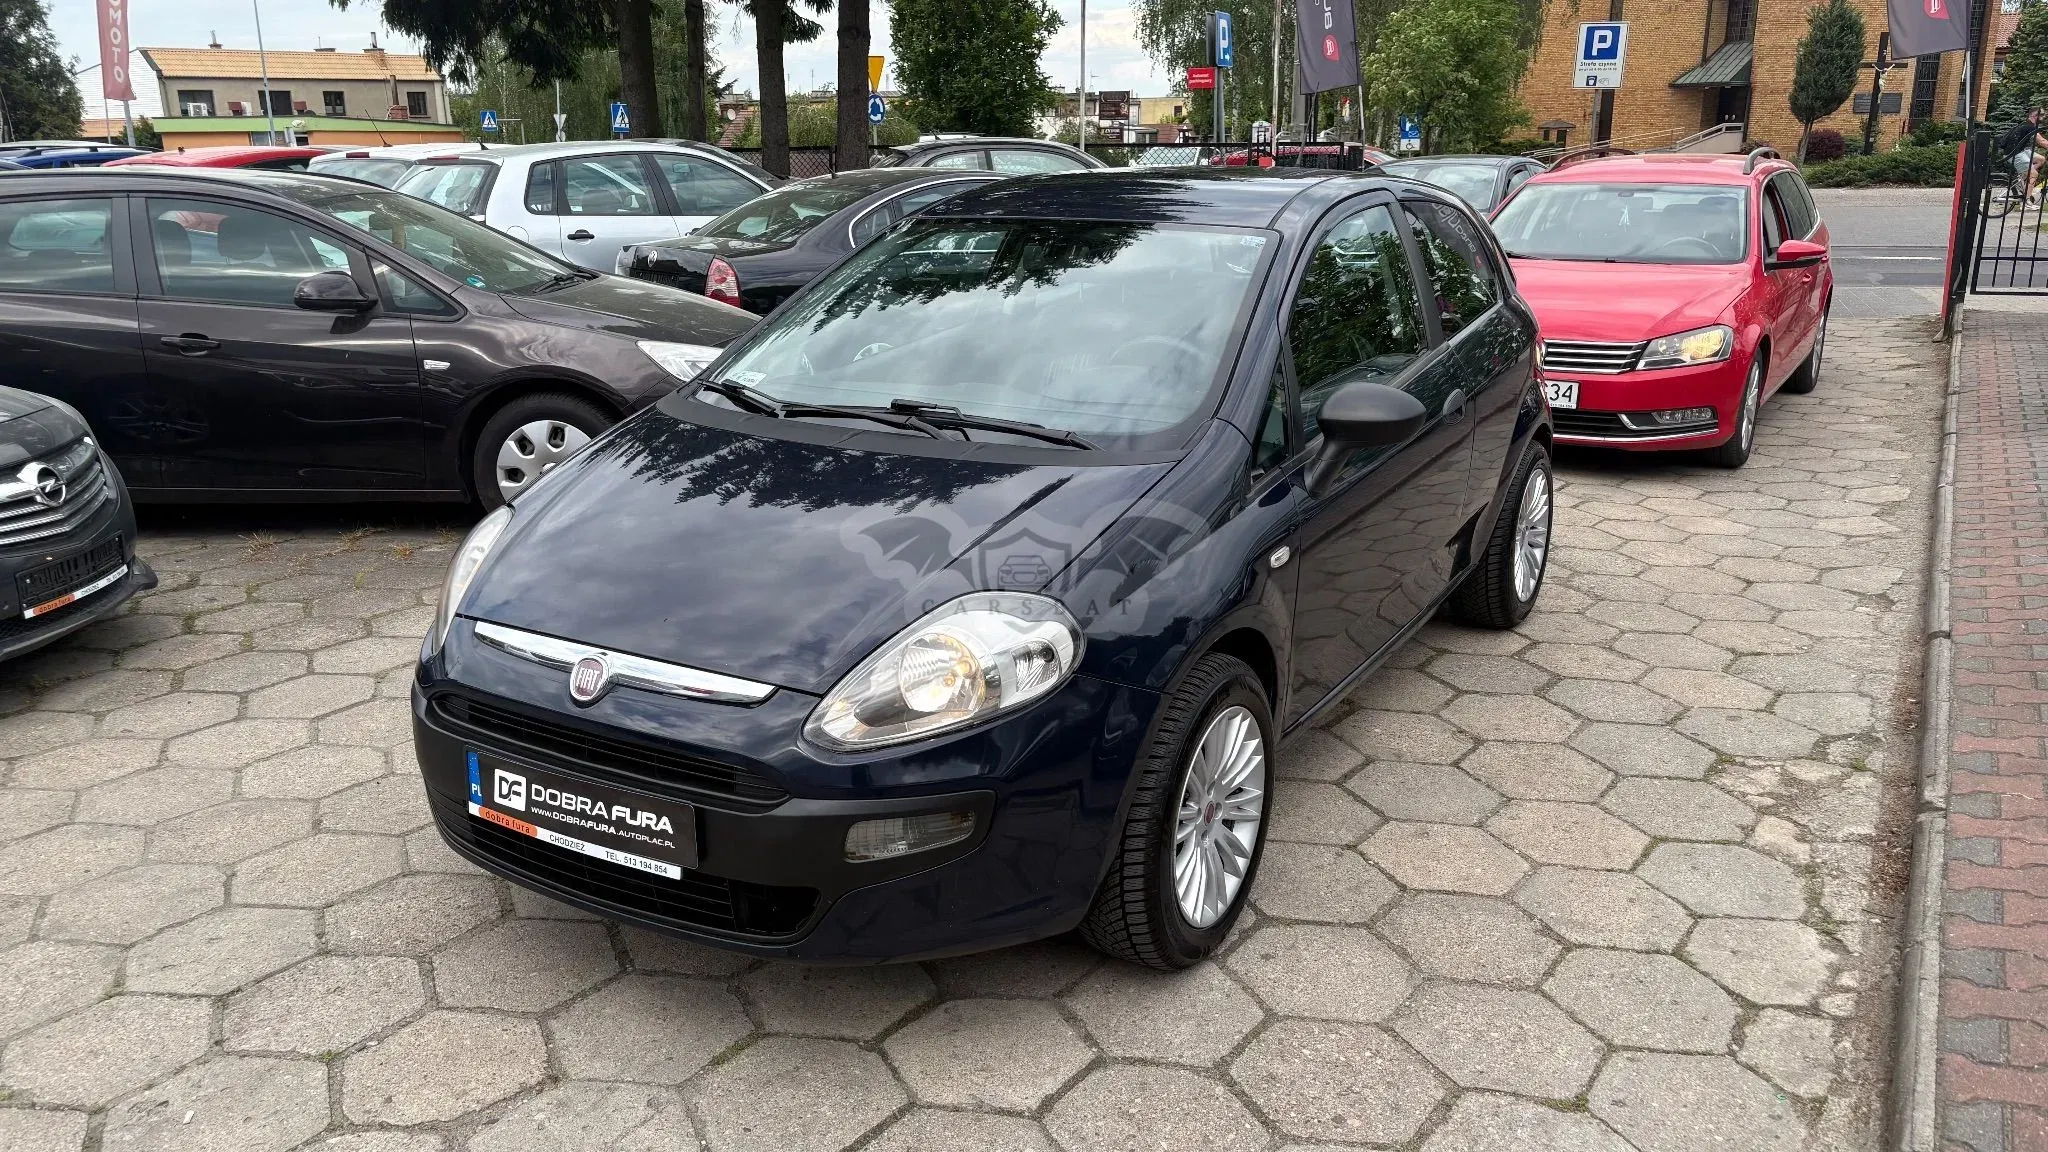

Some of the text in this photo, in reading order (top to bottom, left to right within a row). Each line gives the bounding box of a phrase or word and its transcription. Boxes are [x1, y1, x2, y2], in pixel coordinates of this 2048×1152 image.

[1219, 19, 1228, 60] P
[1592, 30, 1612, 56] P
[576, 668, 600, 691] FIAT
[471, 783, 482, 797] PL
[531, 783, 674, 835] DOBRA FURA
[485, 810, 530, 834] dobra fura
[530, 806, 676, 849] WWW.DOBRAFURA.AUTOPLAC.PL
[549, 834, 586, 852] CHODZIEŻ
[605, 850, 668, 875] TEL. 513 194 854
